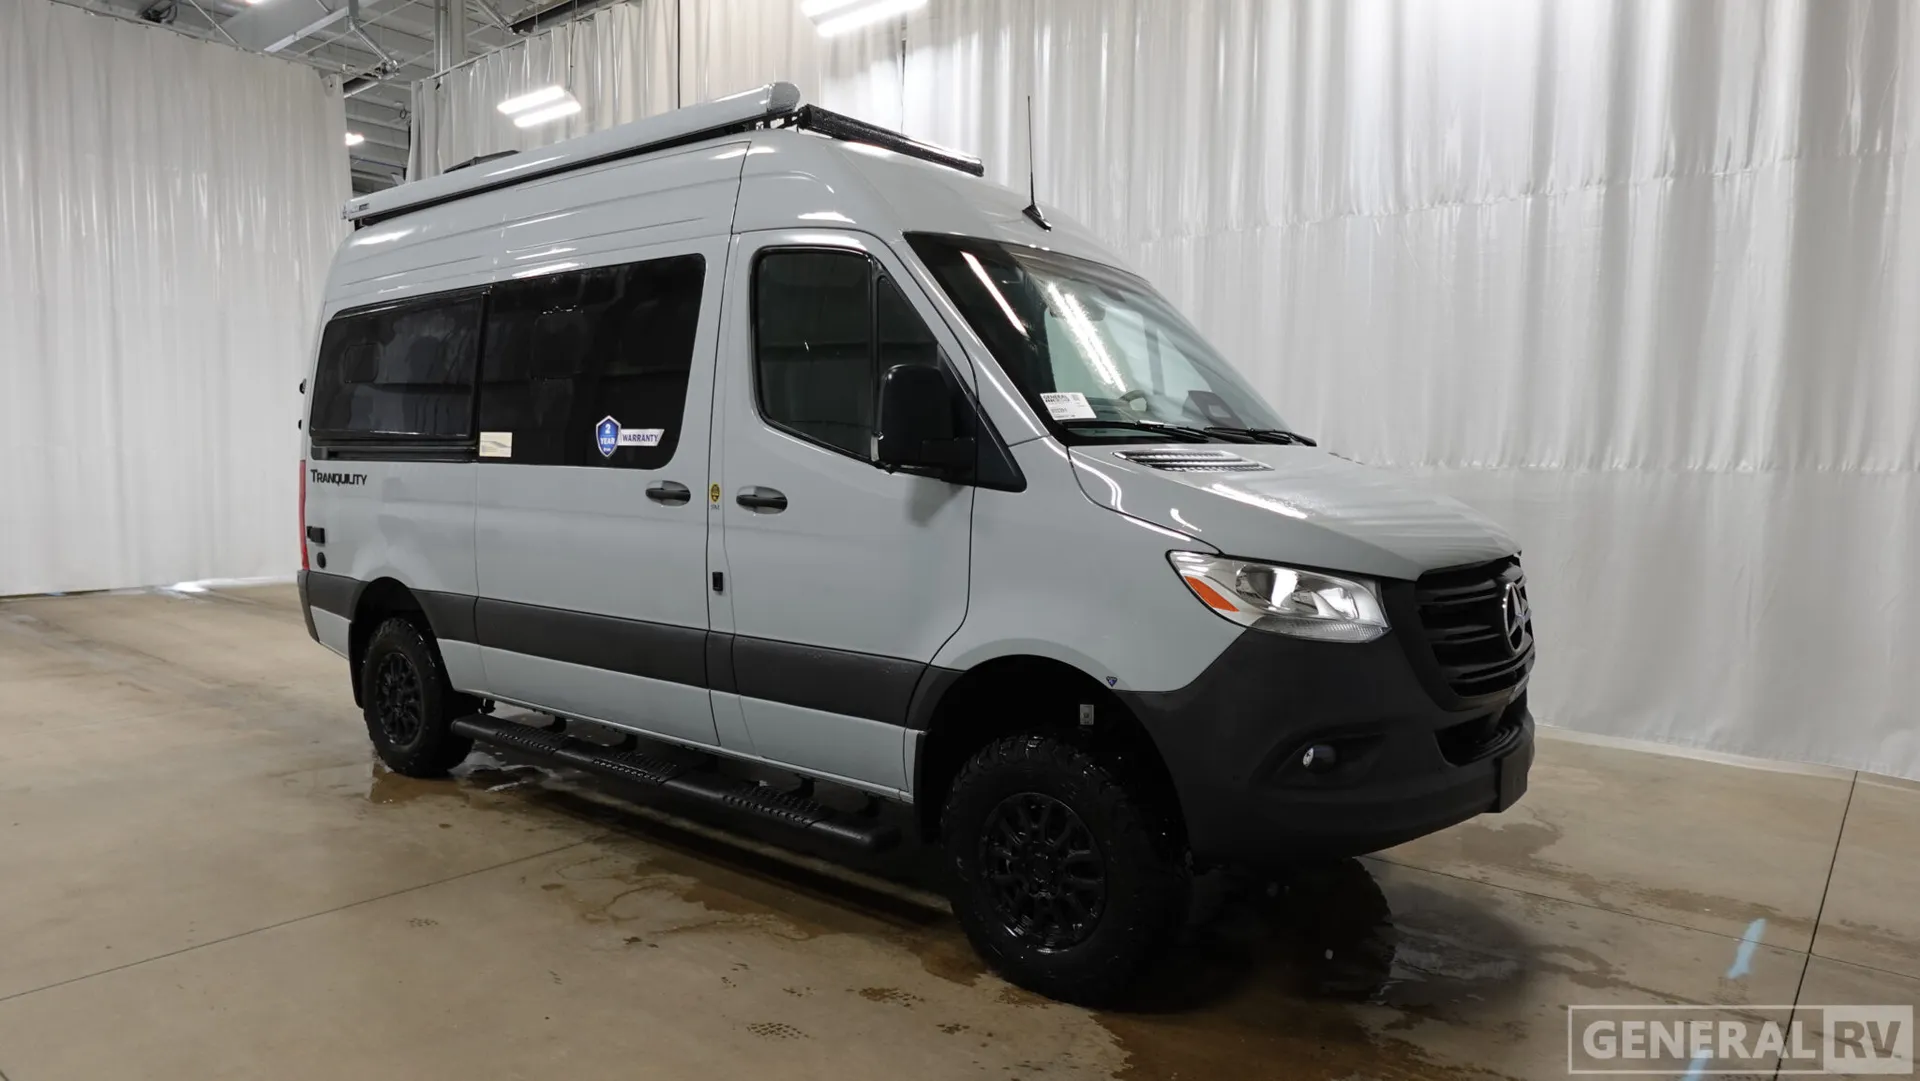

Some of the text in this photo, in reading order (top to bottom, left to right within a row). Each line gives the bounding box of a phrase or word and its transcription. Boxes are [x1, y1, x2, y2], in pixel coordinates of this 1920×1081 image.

[605, 423, 611, 434] 2
[600, 437, 615, 445] YEAR
[622, 434, 659, 442] WARRANTY
[310, 469, 367, 487] TRANQUILITY
